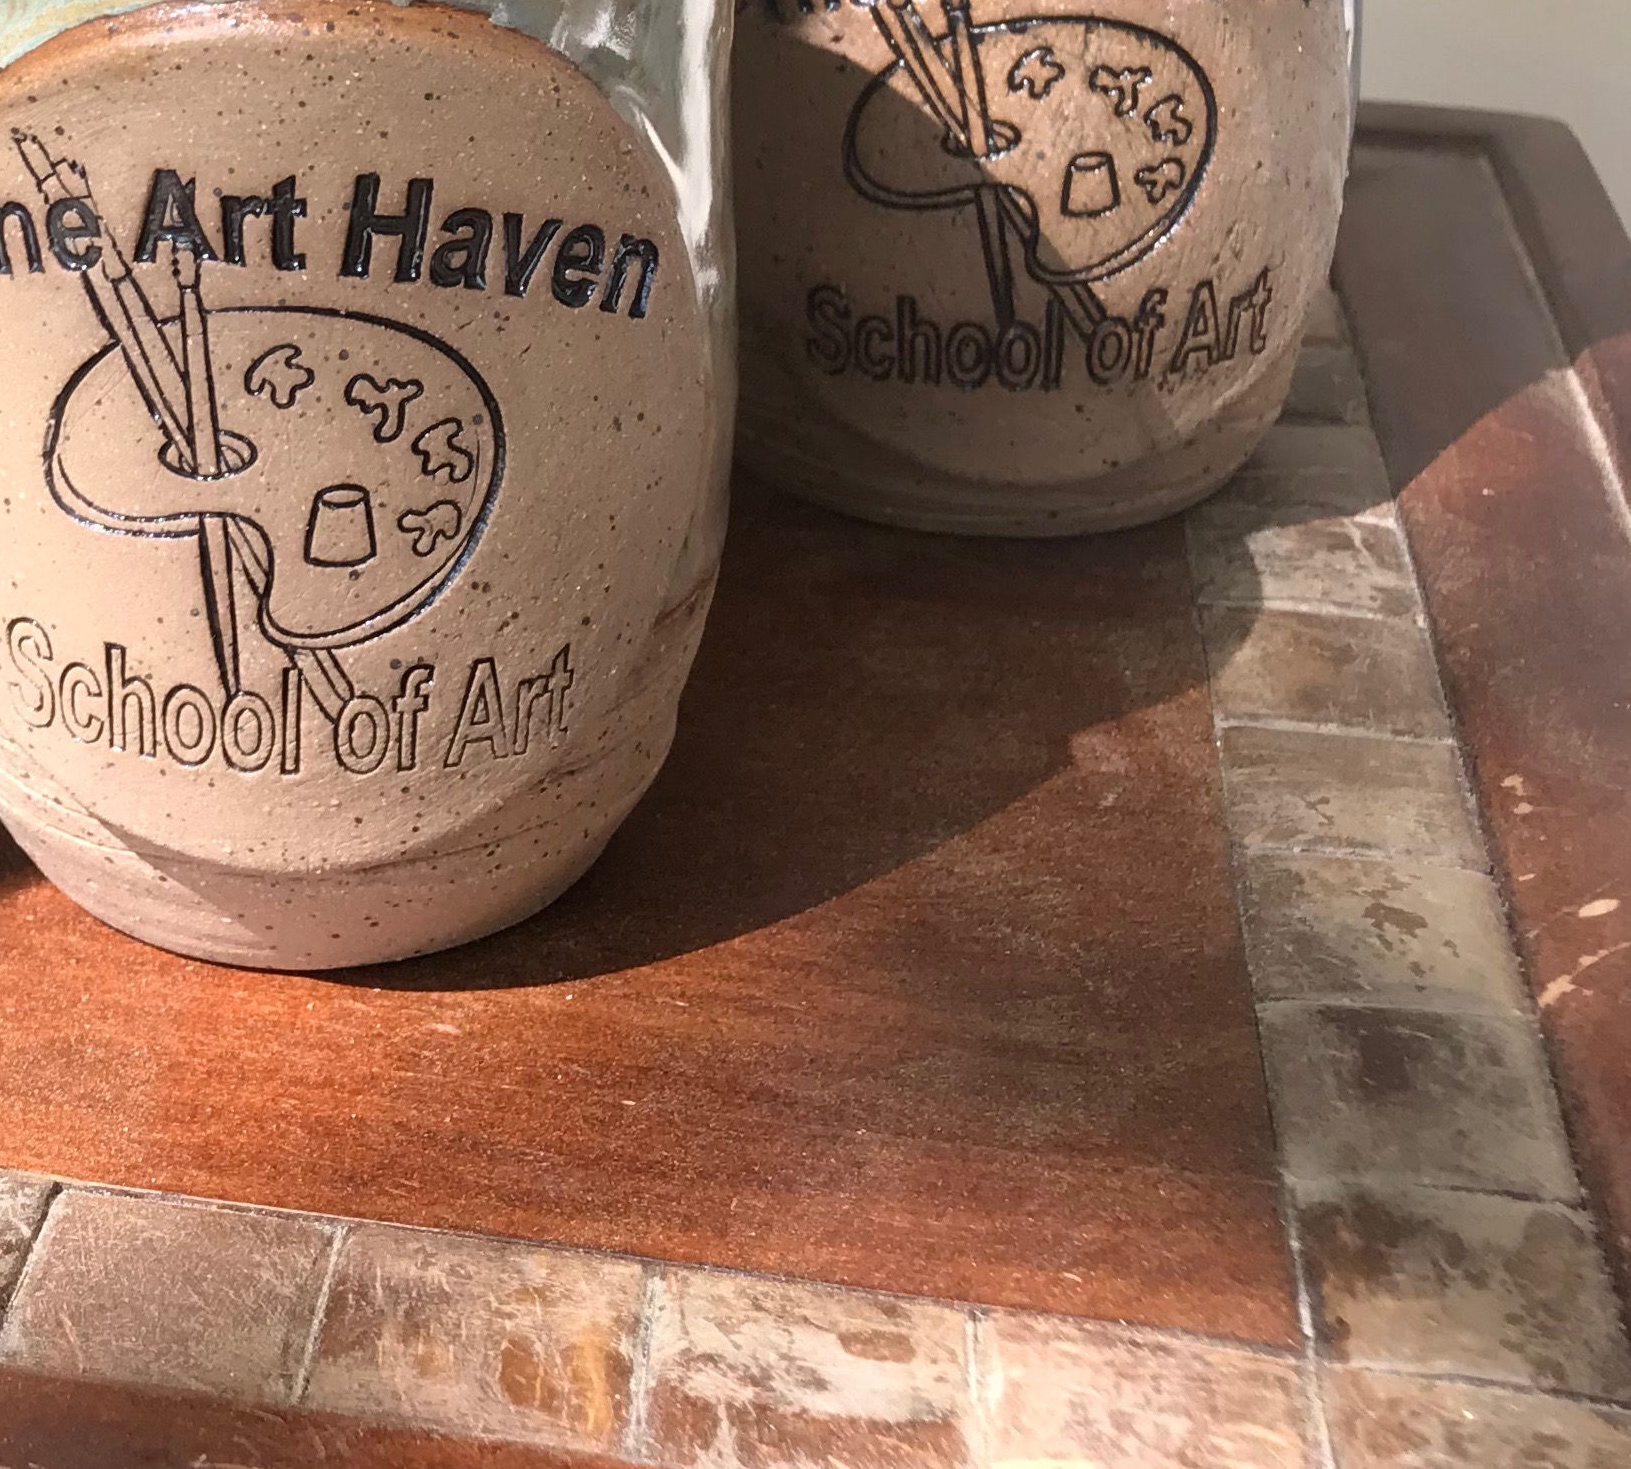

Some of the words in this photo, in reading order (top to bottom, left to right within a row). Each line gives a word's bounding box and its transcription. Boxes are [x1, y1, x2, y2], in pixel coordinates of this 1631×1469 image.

[133, 167, 307, 273] Art
[341, 172, 661, 320] Haven
[805, 282, 1066, 392] School
[1085, 288, 1168, 389] of
[1173, 270, 1274, 377] Art
[6, 616, 303, 775] School
[336, 661, 434, 775] of
[442, 643, 576, 770] Art
